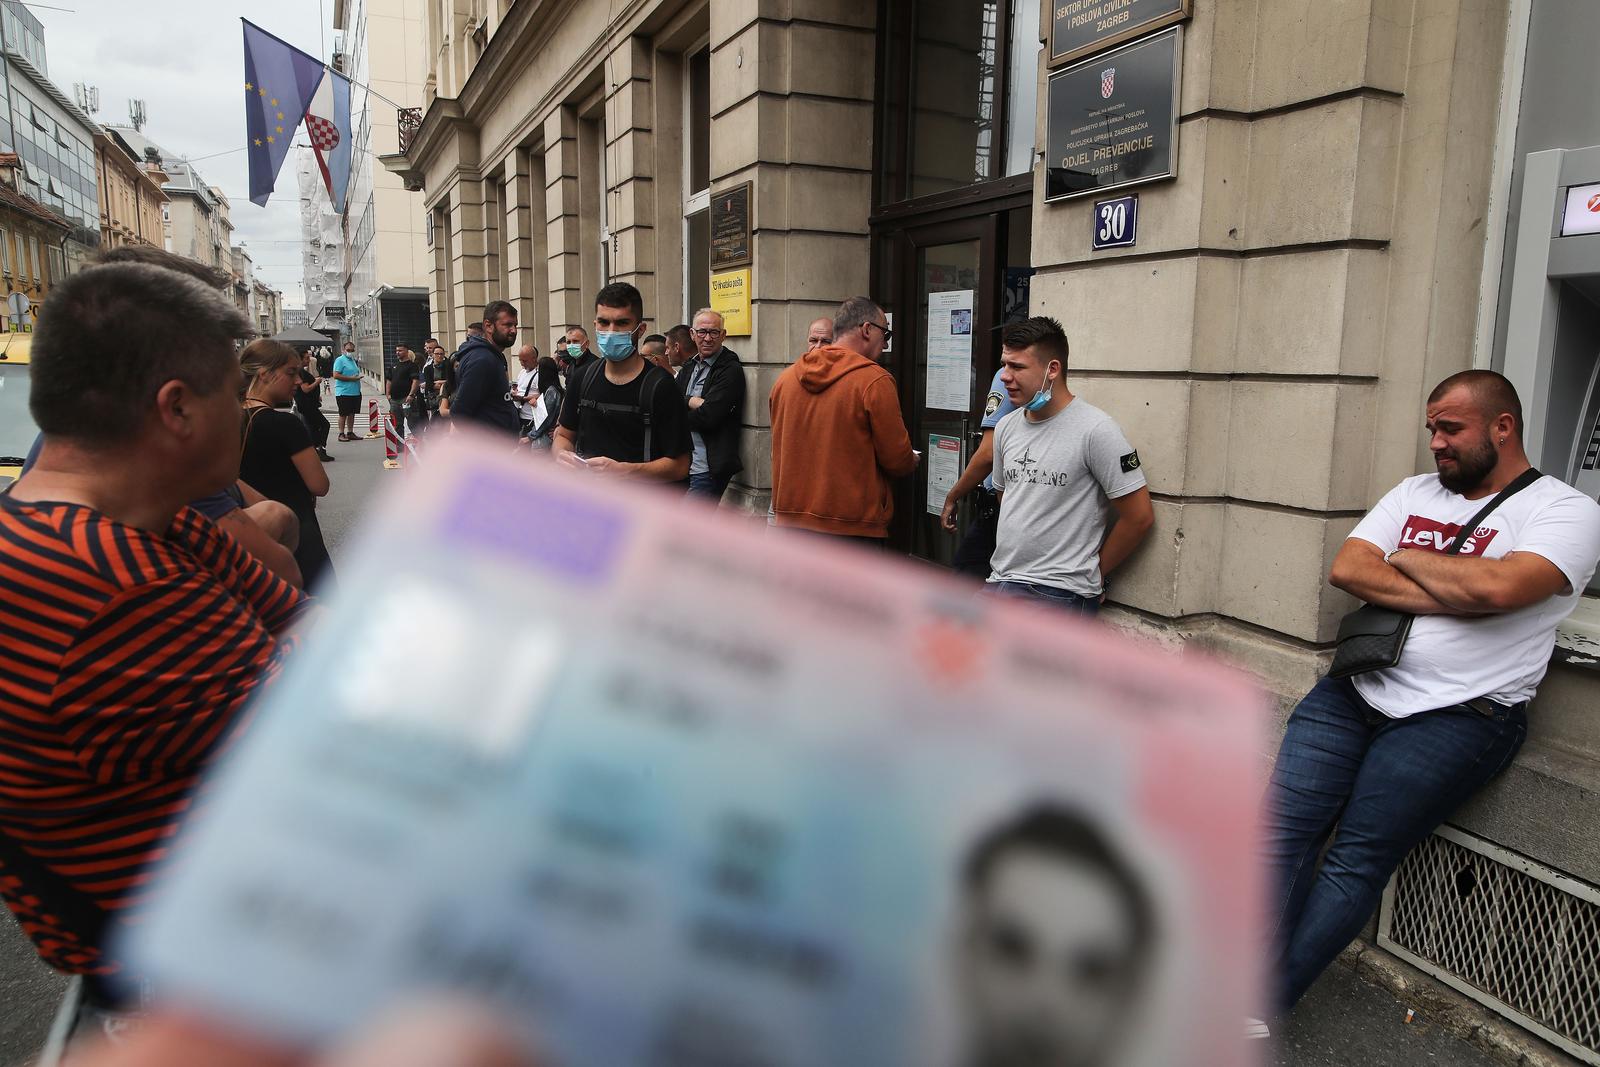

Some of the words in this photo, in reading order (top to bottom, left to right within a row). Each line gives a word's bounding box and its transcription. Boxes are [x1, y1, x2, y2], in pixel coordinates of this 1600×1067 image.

[1056, 1, 1082, 20] SEKTOR
[1067, 19, 1071, 30] I
[1071, 7, 1102, 28] POSLOVA
[1097, 11, 1129, 32] ZAGREB
[1070, 122, 1098, 135] MINISTARSTVO
[1125, 109, 1145, 119] POSLOVA
[1066, 137, 1094, 150] POLICIJSKA
[1094, 131, 1113, 143] UPRAVA
[1114, 121, 1149, 137] ZAGREBAČKA
[1062, 152, 1090, 169] ODJEL
[1093, 135, 1153, 161] PREVENCIJE
[1091, 163, 1119, 176] ZAGREB
[1100, 203, 1126, 241] 30
[1017, 276, 1029, 288] 25
[1402, 527, 1477, 554] Levs
